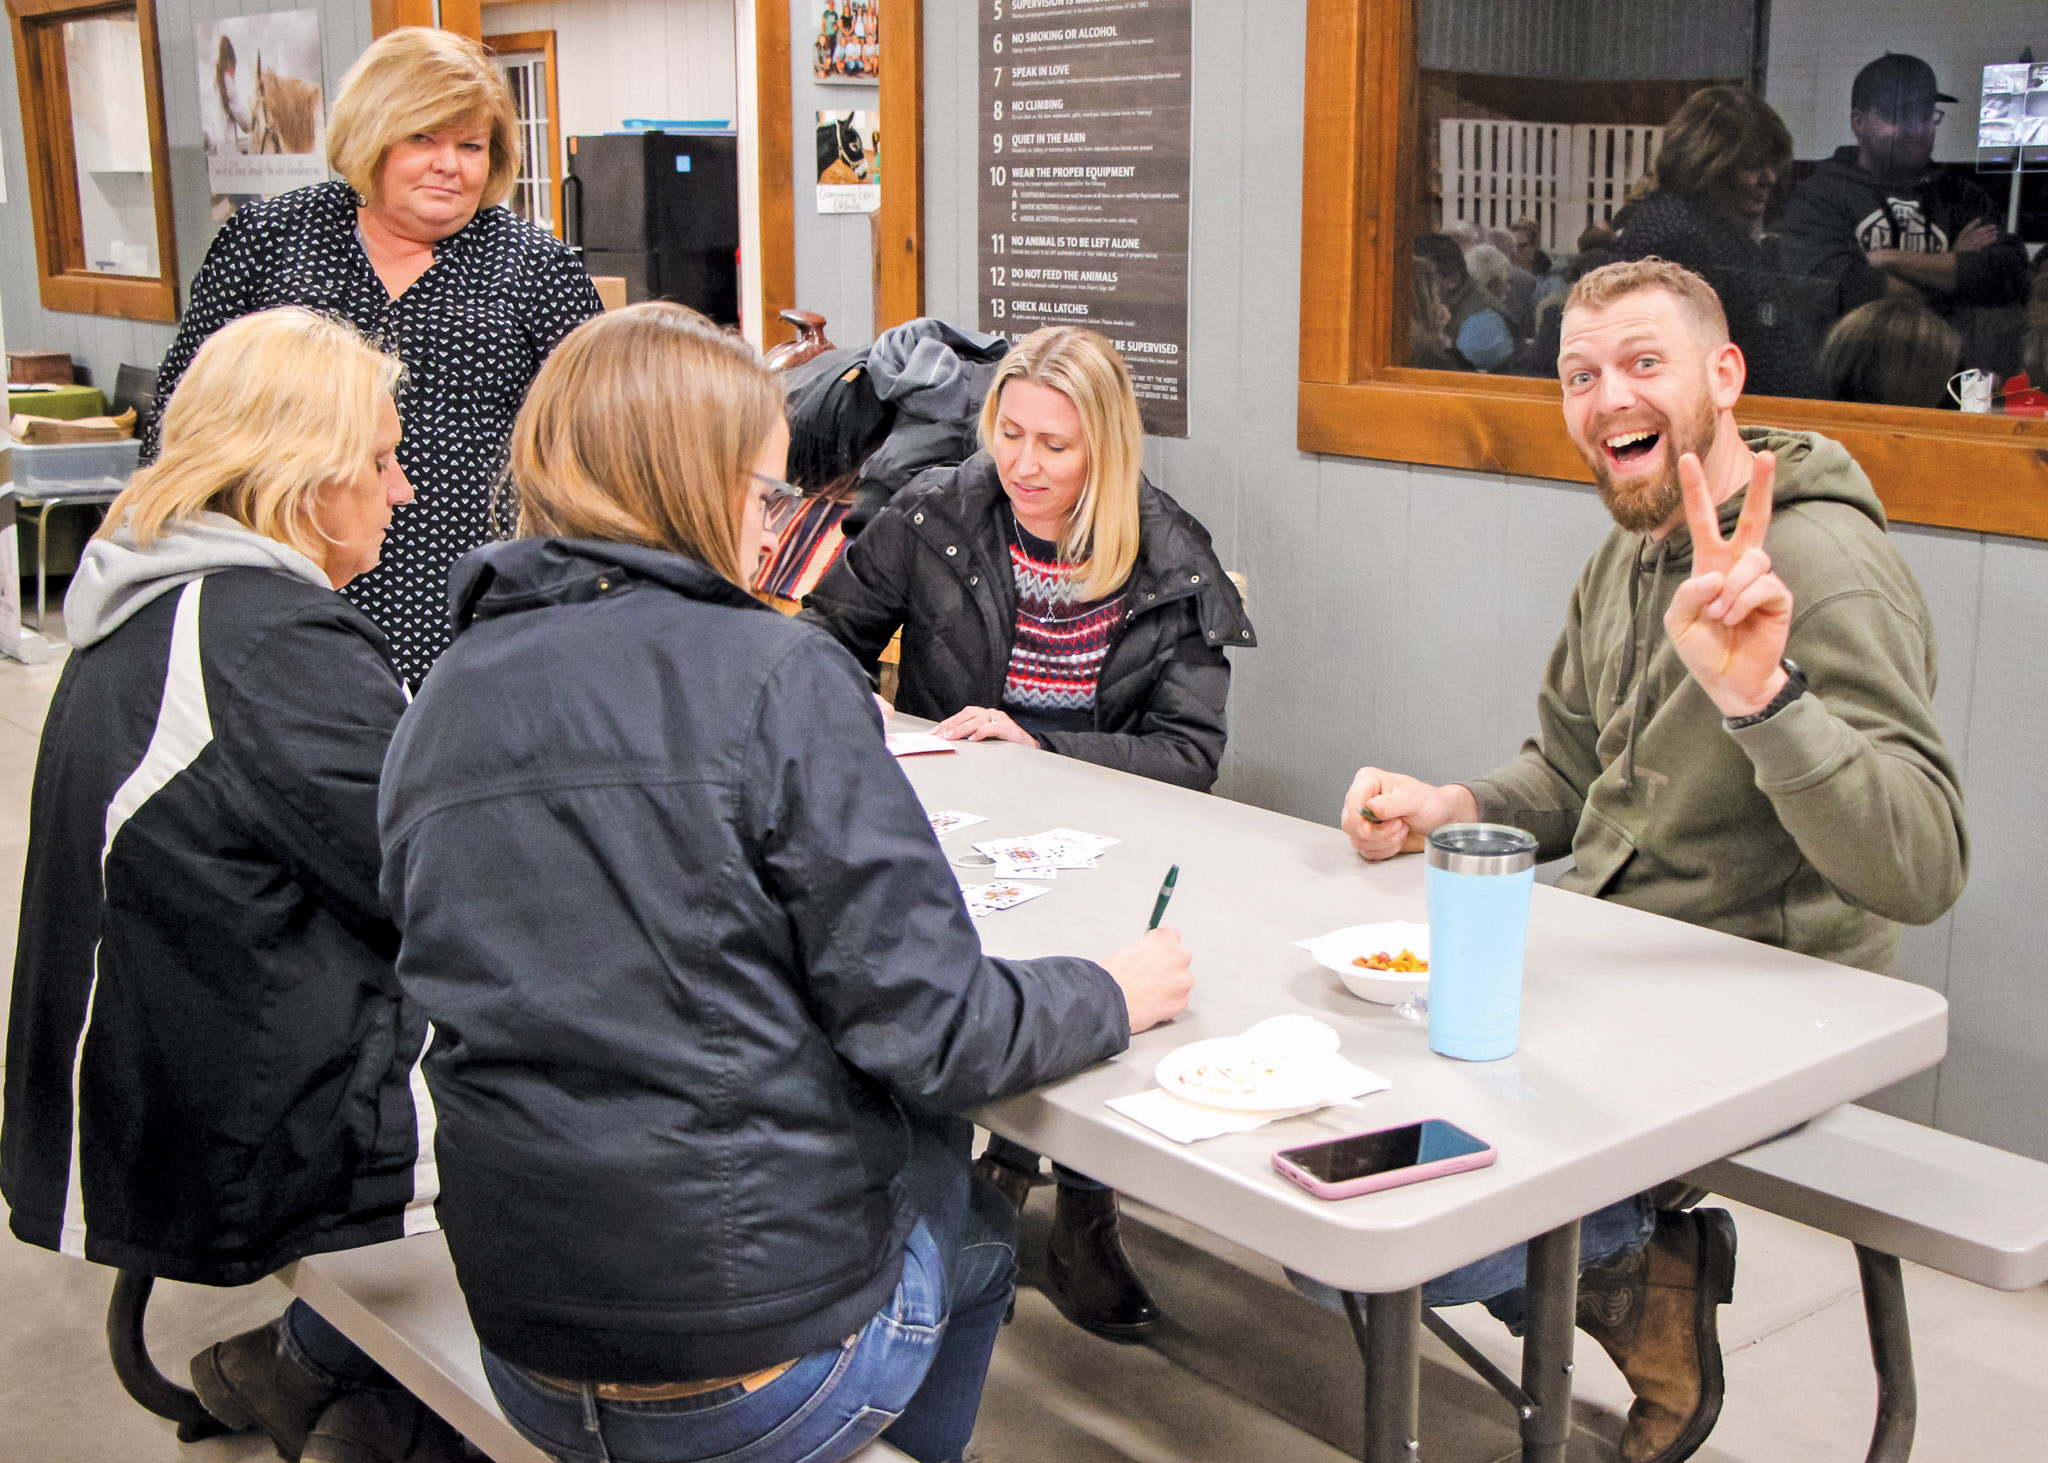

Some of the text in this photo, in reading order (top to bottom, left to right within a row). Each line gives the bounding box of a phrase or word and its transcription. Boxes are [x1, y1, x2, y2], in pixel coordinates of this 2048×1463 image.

[993, 1, 1002, 20] 5
[1012, 0, 1065, 10] SUPERVISION
[993, 34, 1003, 54] 6
[1012, 34, 1024, 44] NO
[1026, 30, 1063, 43] SMOKING
[1065, 29, 1077, 39] OR
[1079, 26, 1117, 38] ALCOHOL
[993, 68, 1002, 87] 7
[1012, 66, 1037, 78] SPEAK
[1039, 66, 1047, 76] IN
[1049, 65, 1069, 75] LOVE
[993, 100, 1003, 120] 8
[1012, 101, 1024, 111] NO
[1026, 99, 1063, 110] CLIMBING
[993, 134, 1003, 153] 9
[1012, 134, 1034, 147] QUIET
[1036, 134, 1045, 144] IN
[1047, 133, 1062, 143] THE
[1064, 133, 1085, 143] BARN
[990, 166, 1006, 186] 10
[1012, 168, 1034, 178] WEAR
[1036, 168, 1051, 177] THE
[1052, 167, 1084, 177] PROPER
[1086, 166, 1135, 179] EQUIPMENT
[1012, 189, 1017, 199] A
[1012, 201, 1017, 210] B
[1012, 213, 1017, 222] C
[991, 234, 1005, 254] 11
[1012, 236, 1024, 246] NO
[1025, 237, 1056, 247] ANIMAL
[1057, 237, 1065, 247] IS
[1067, 237, 1078, 248] TO
[1079, 237, 1089, 248] BE
[1091, 238, 1110, 248] LEFT
[1112, 238, 1139, 249] ALONE
[990, 266, 1005, 287] 12
[1012, 269, 1024, 279] DO
[1025, 269, 1041, 280] NOT
[1042, 270, 1062, 280] FEED
[1063, 270, 1079, 281] THE
[1080, 271, 1118, 282] ANIMALS
[990, 299, 1088, 318] 13 CHECK ALL LATCHES
[1115, 341, 1126, 351] BE
[1127, 342, 1178, 354] SUPERVISED
